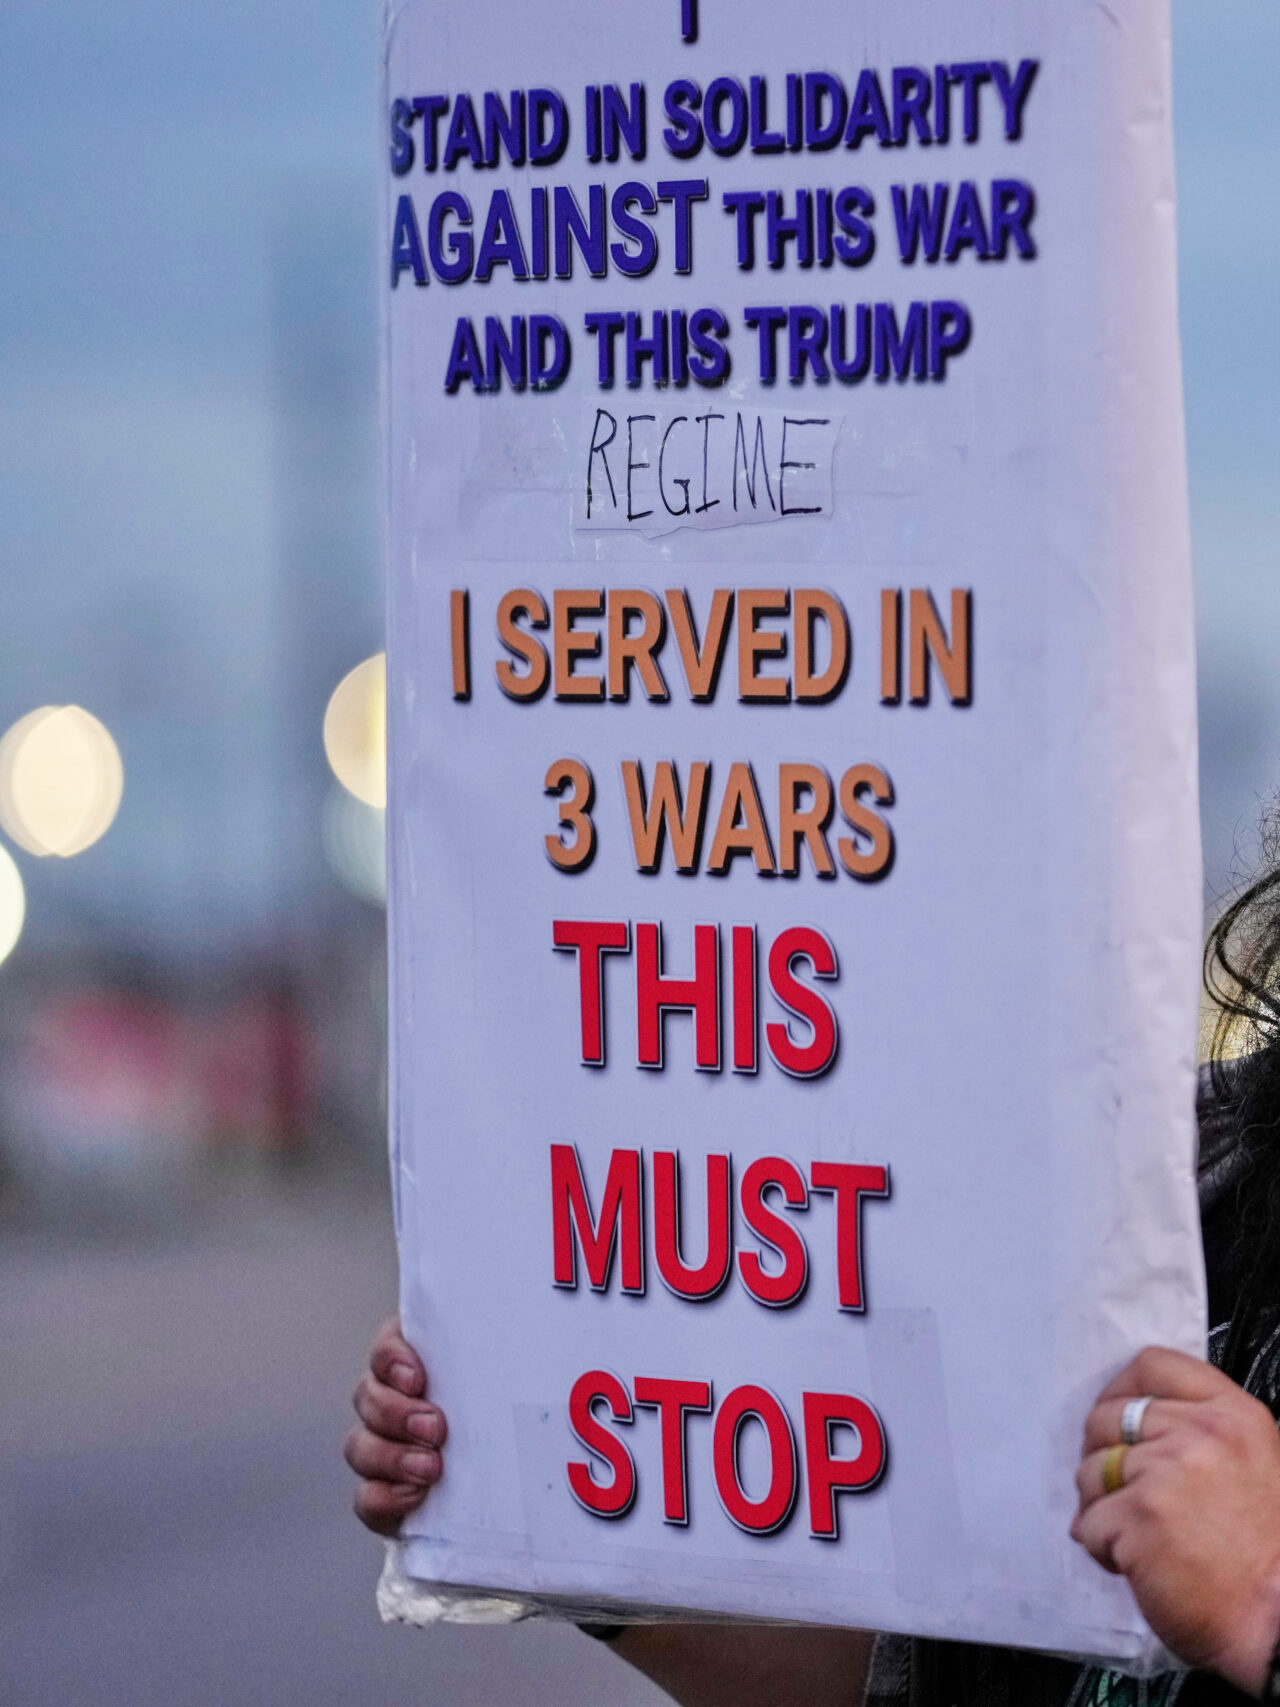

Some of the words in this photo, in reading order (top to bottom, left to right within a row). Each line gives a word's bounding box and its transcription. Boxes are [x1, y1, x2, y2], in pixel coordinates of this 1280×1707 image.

[390, 87, 570, 177] STAND
[584, 82, 649, 162] IN
[663, 59, 1040, 160] SOLIDARITY
[390, 177, 708, 289] AGAINST
[724, 186, 878, 272] THIS
[891, 179, 1037, 266] WAR
[444, 313, 573, 396] AND
[584, 309, 733, 391] THIS
[743, 301, 972, 386] TRUMP
[586, 408, 831, 522] REGIME
[449, 588, 471, 702] I
[494, 586, 852, 705] SERVED
[879, 587, 975, 708] IN
[543, 758, 596, 875] 3
[620, 760, 897, 883] WARS
[552, 919, 840, 1080] THIS
[549, 1143, 892, 1313] MUST
[566, 1369, 888, 1541] STOP
